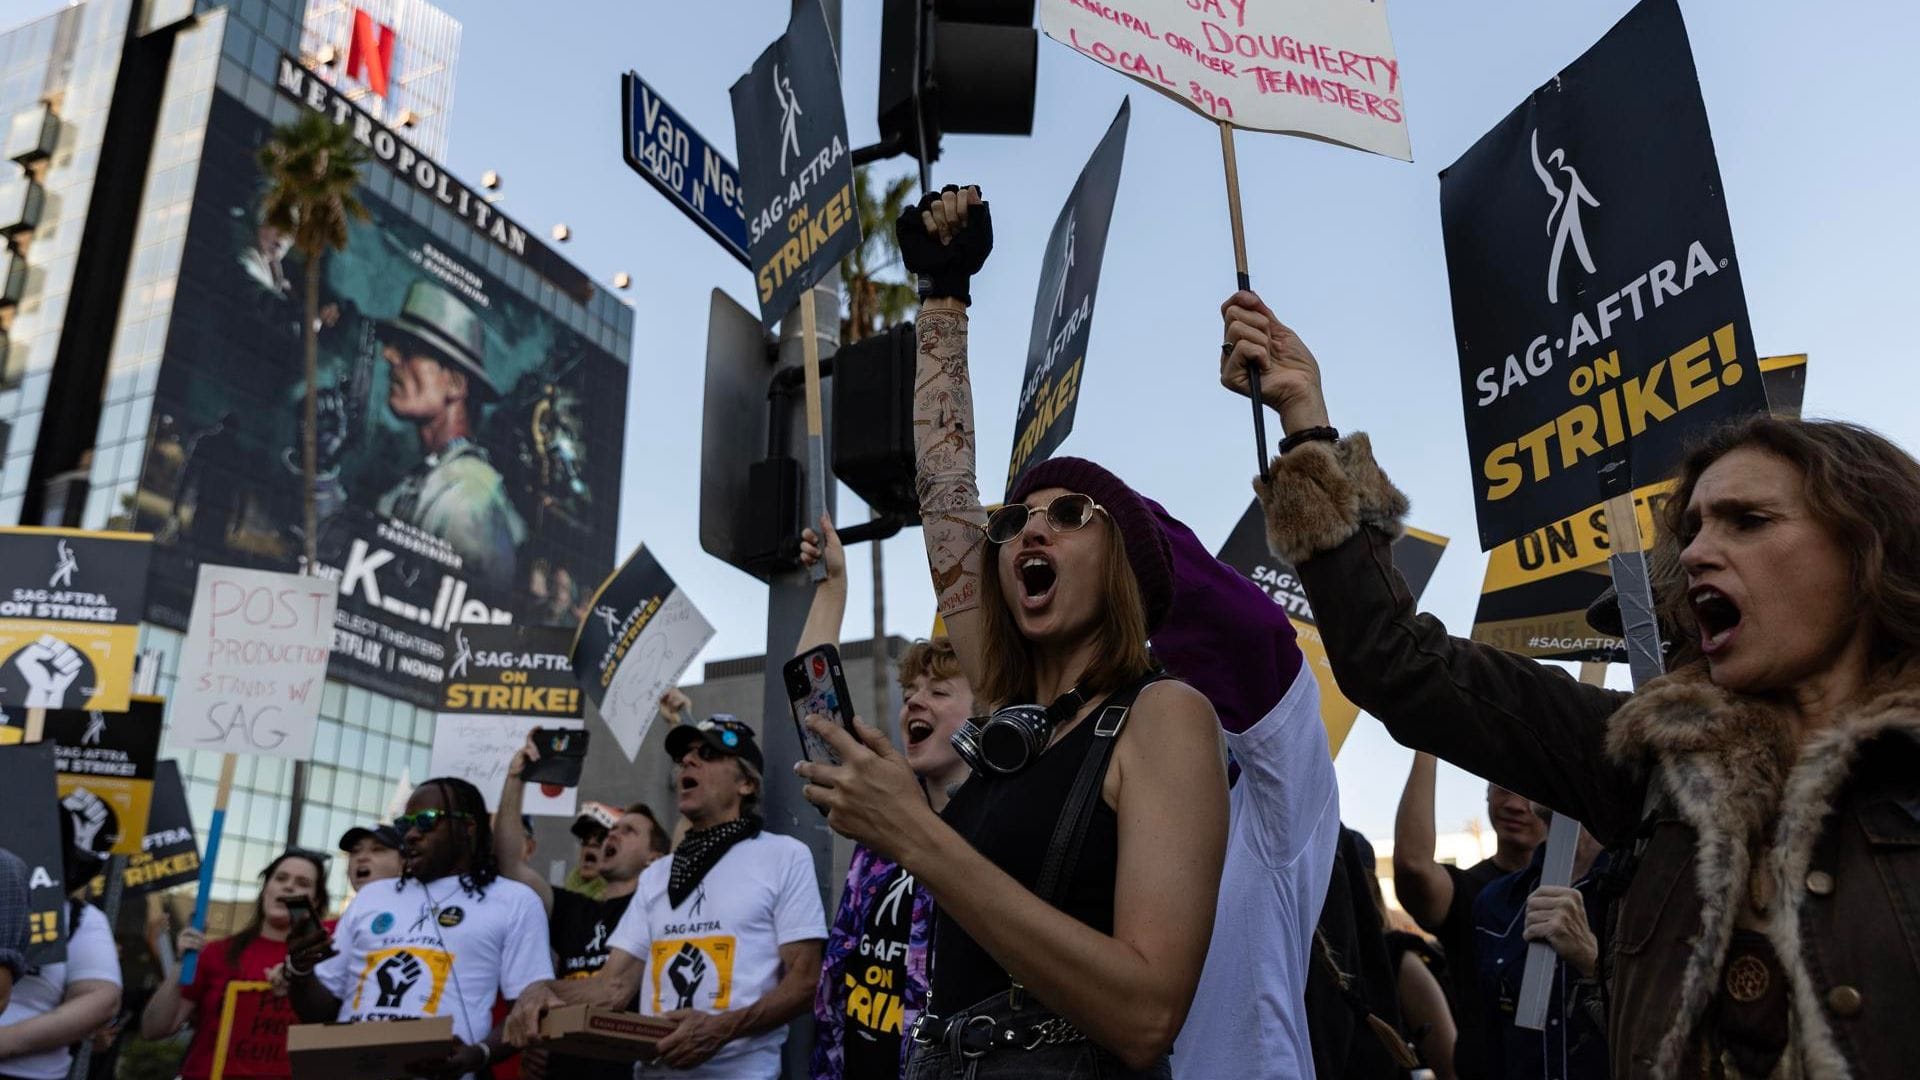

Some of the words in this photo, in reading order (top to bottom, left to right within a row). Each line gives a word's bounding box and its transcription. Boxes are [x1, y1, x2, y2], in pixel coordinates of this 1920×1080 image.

[346, 8, 396, 97] N
[1069, 0, 1159, 40] INCIPAL
[1165, 32, 1239, 78] OFFICER
[1242, 66, 1401, 124] TEAMSTERS
[1070, 28, 1177, 86] LOCAL
[1189, 81, 1233, 118] 399
[1201, 21, 1399, 94] DOUGHERTY
[278, 57, 527, 256] METROPOLITAN
[638, 131, 685, 192] 1400
[692, 178, 706, 213] N
[641, 85, 690, 168] Van
[704, 146, 746, 220] Nes
[788, 203, 809, 233] ON
[759, 184, 853, 304] STRIKE!
[1035, 375, 1053, 410] ON
[1568, 350, 1621, 396] ON
[1483, 322, 1743, 501] STRIKE!
[1515, 520, 1578, 571] ON
[0, 601, 33, 616] ON
[36, 602, 118, 622] STRIKE!
[209, 580, 330, 638] POST
[207, 638, 329, 668] PRODUCTION
[332, 627, 383, 668] ETFLIX
[1528, 634, 1671, 654] #SAGAFTRA
[446, 683, 580, 712] STRIKE!
[501, 671, 528, 684] ON
[195, 701, 290, 750] SAG
[122, 851, 200, 887] RIKE!
[865, 965, 893, 988] ON
